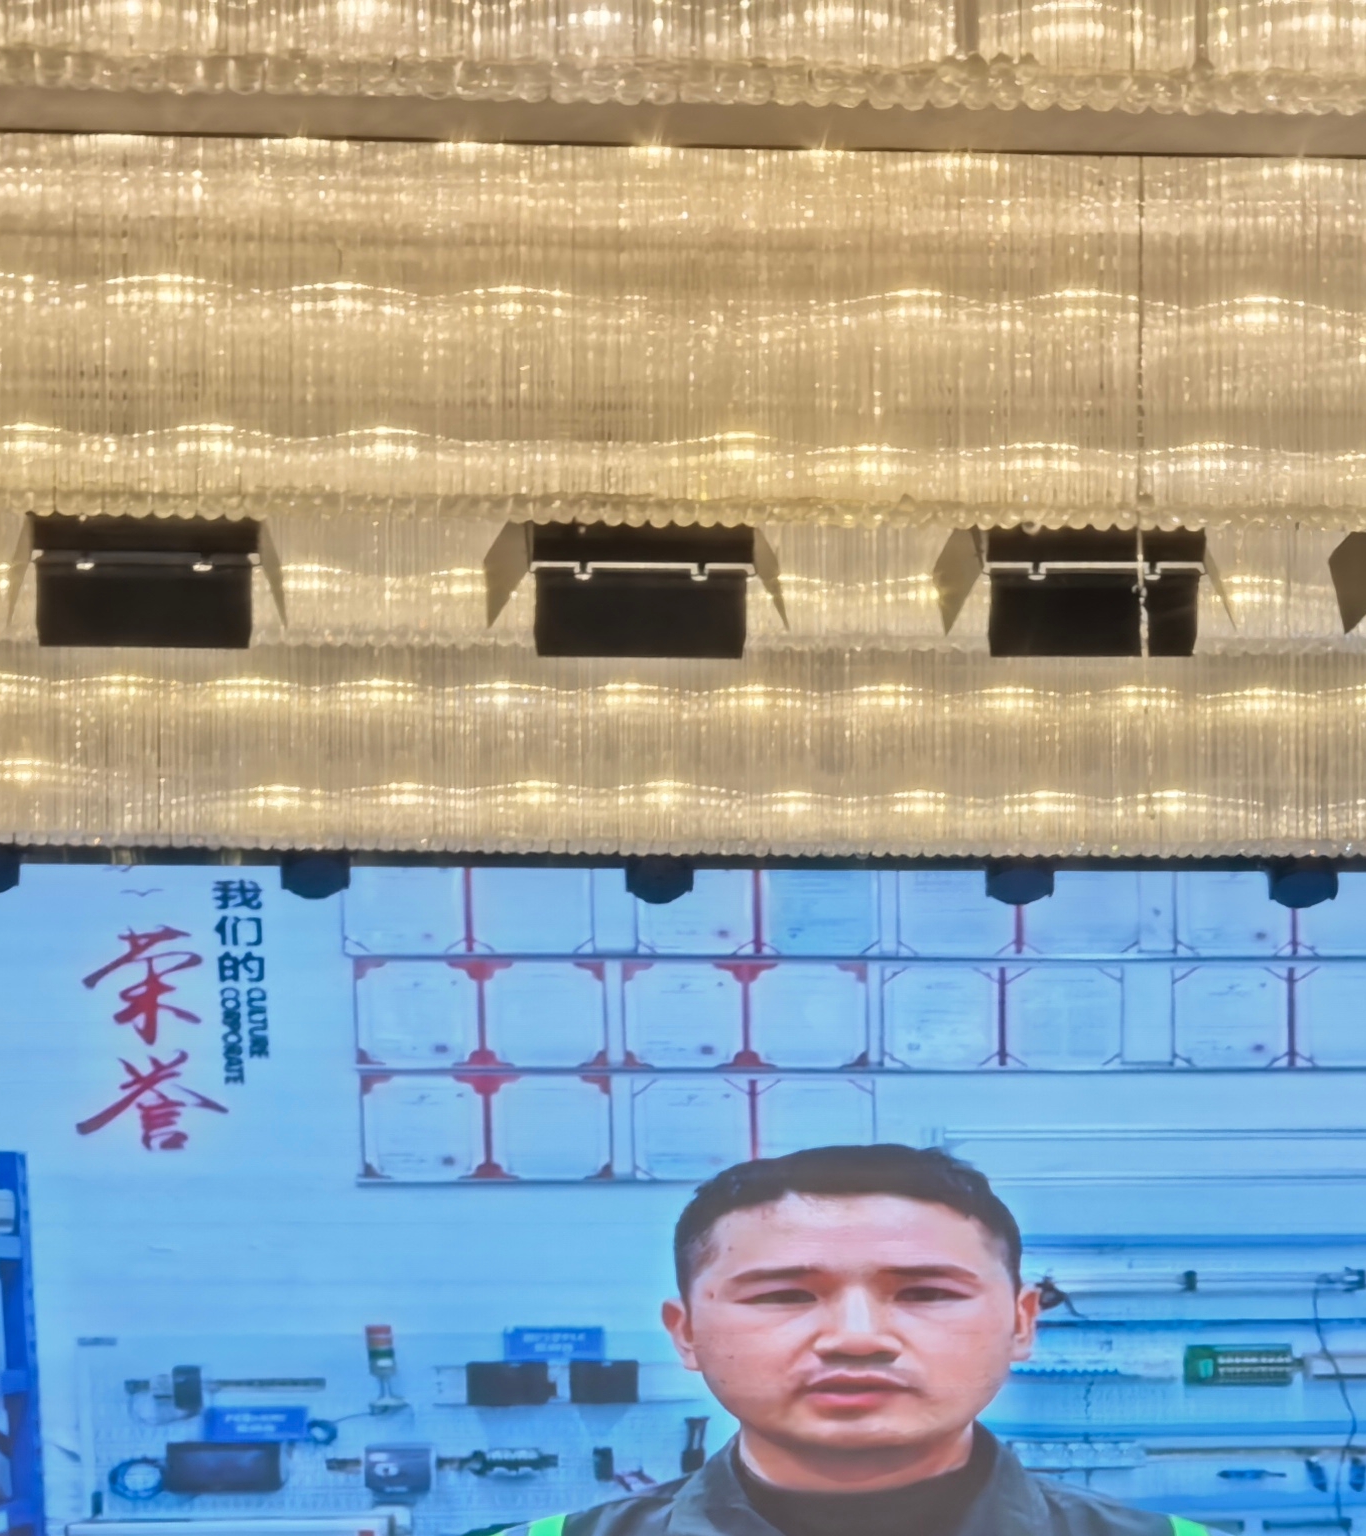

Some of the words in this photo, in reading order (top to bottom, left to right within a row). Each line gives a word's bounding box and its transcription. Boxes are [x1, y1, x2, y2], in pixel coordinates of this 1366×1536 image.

[213, 880, 264, 982] 我们的
[76, 924, 229, 1151] 荣誉
